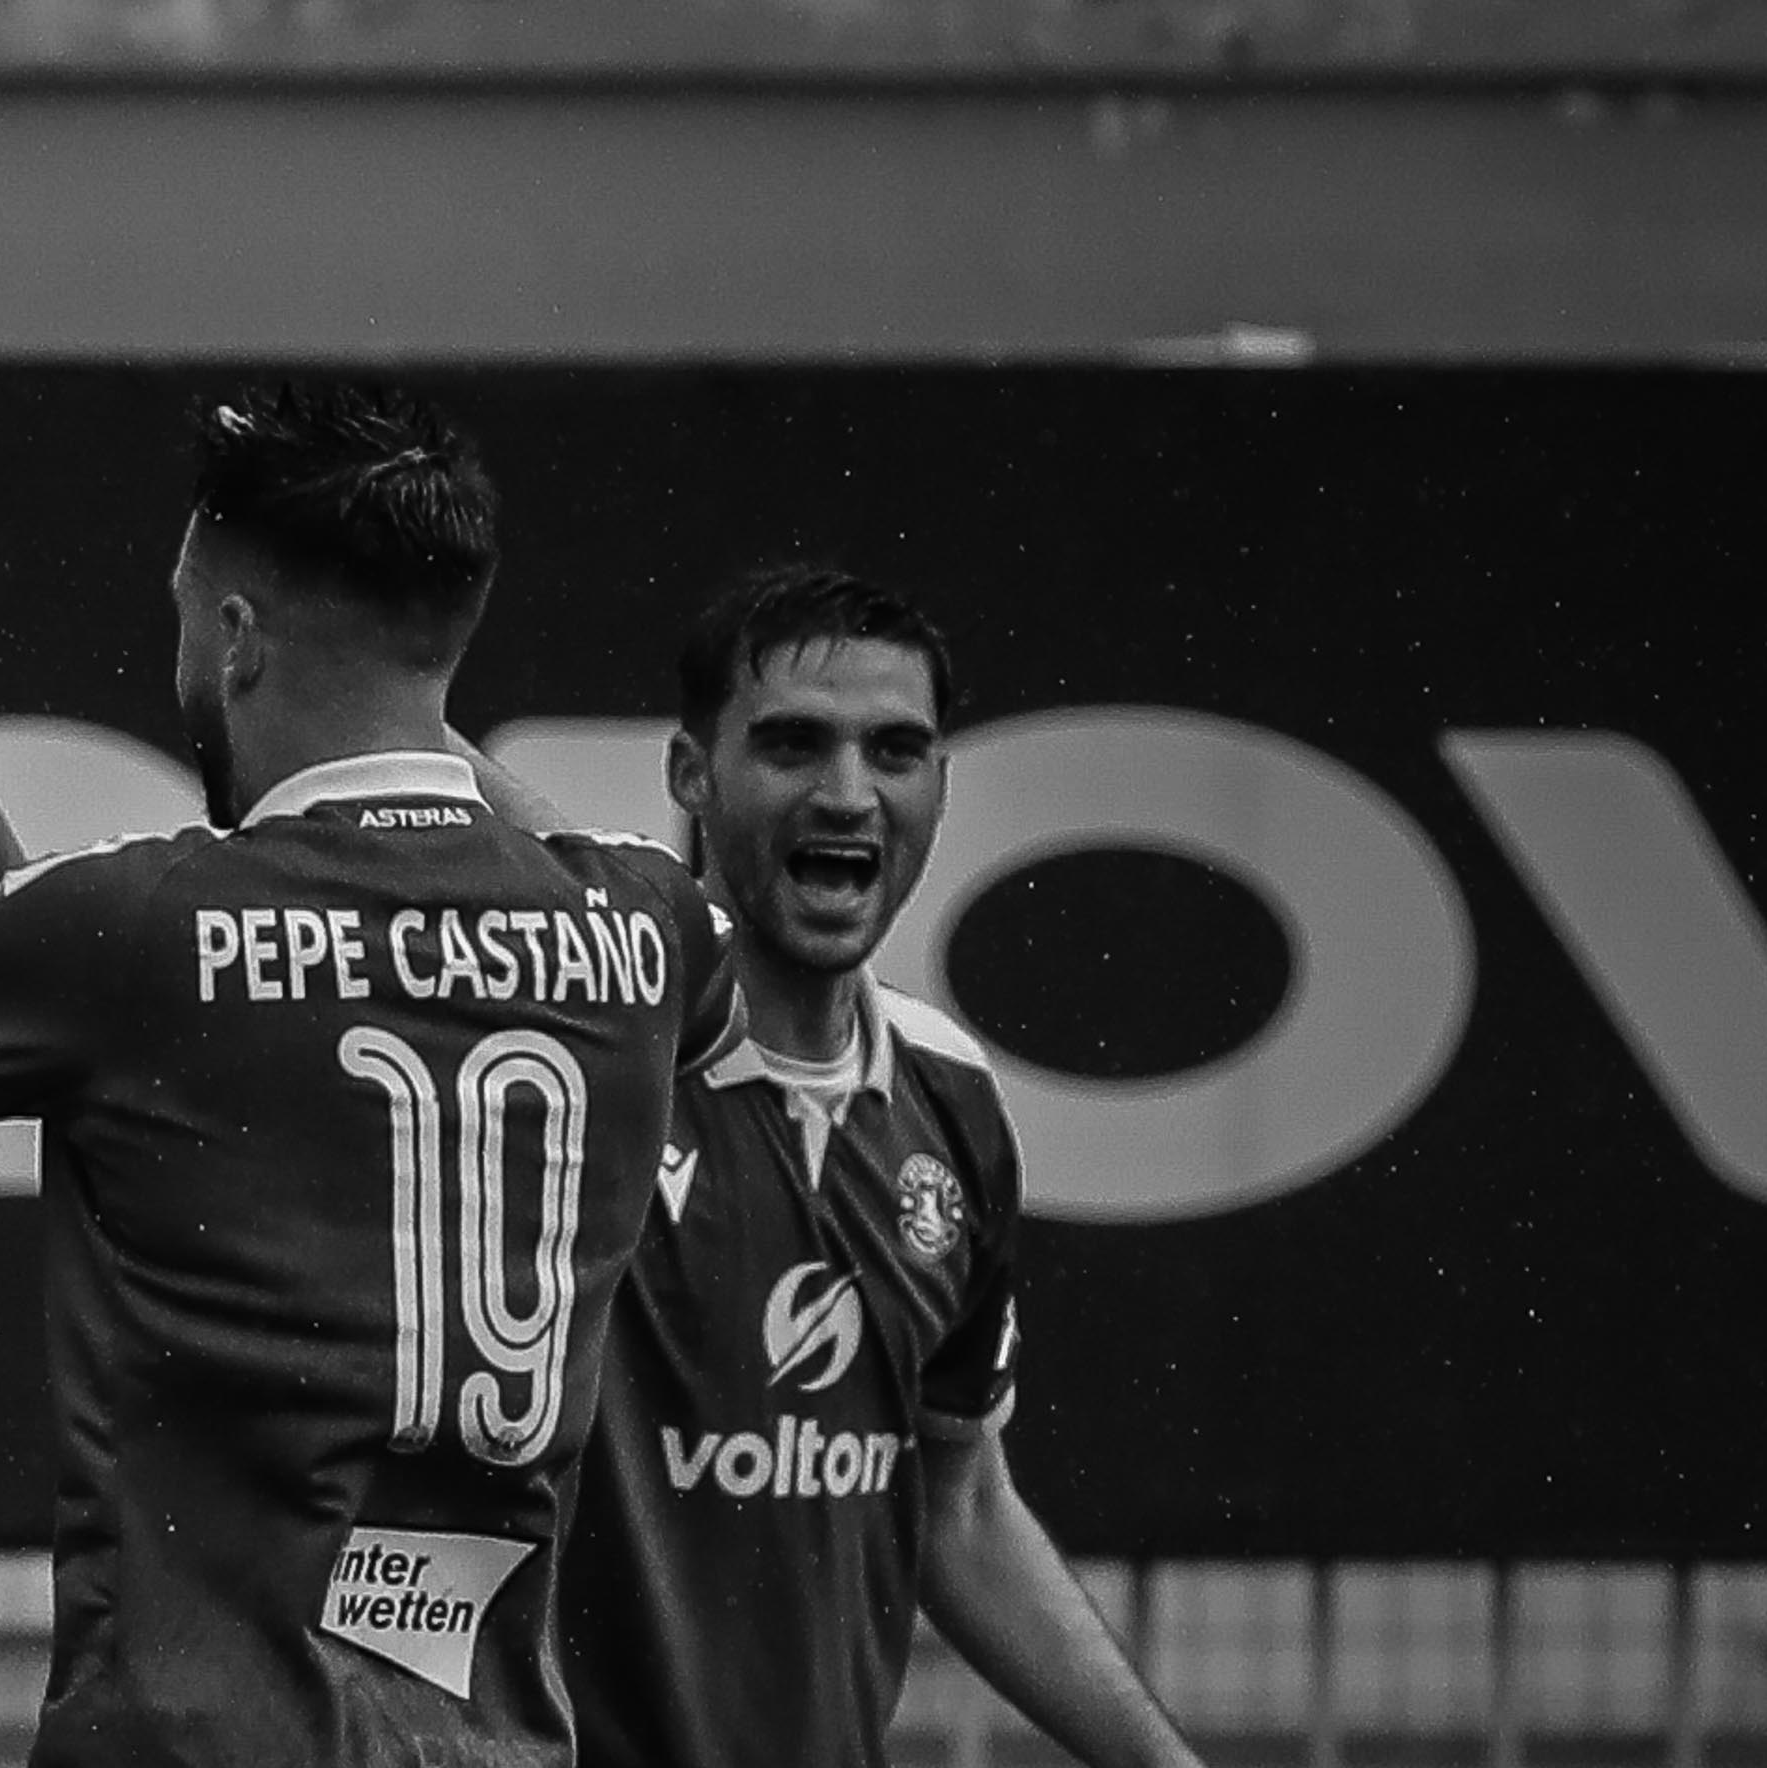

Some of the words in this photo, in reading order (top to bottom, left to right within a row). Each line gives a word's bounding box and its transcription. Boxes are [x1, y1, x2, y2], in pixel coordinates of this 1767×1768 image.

[359, 807, 473, 829] ASTERAS
[195, 909, 370, 1002] PEPE
[387, 887, 666, 1005] CASTAÑO
[337, 1026, 589, 1466] 19
[660, 1414, 901, 1497] volton
[338, 1590, 475, 1633] wetten
